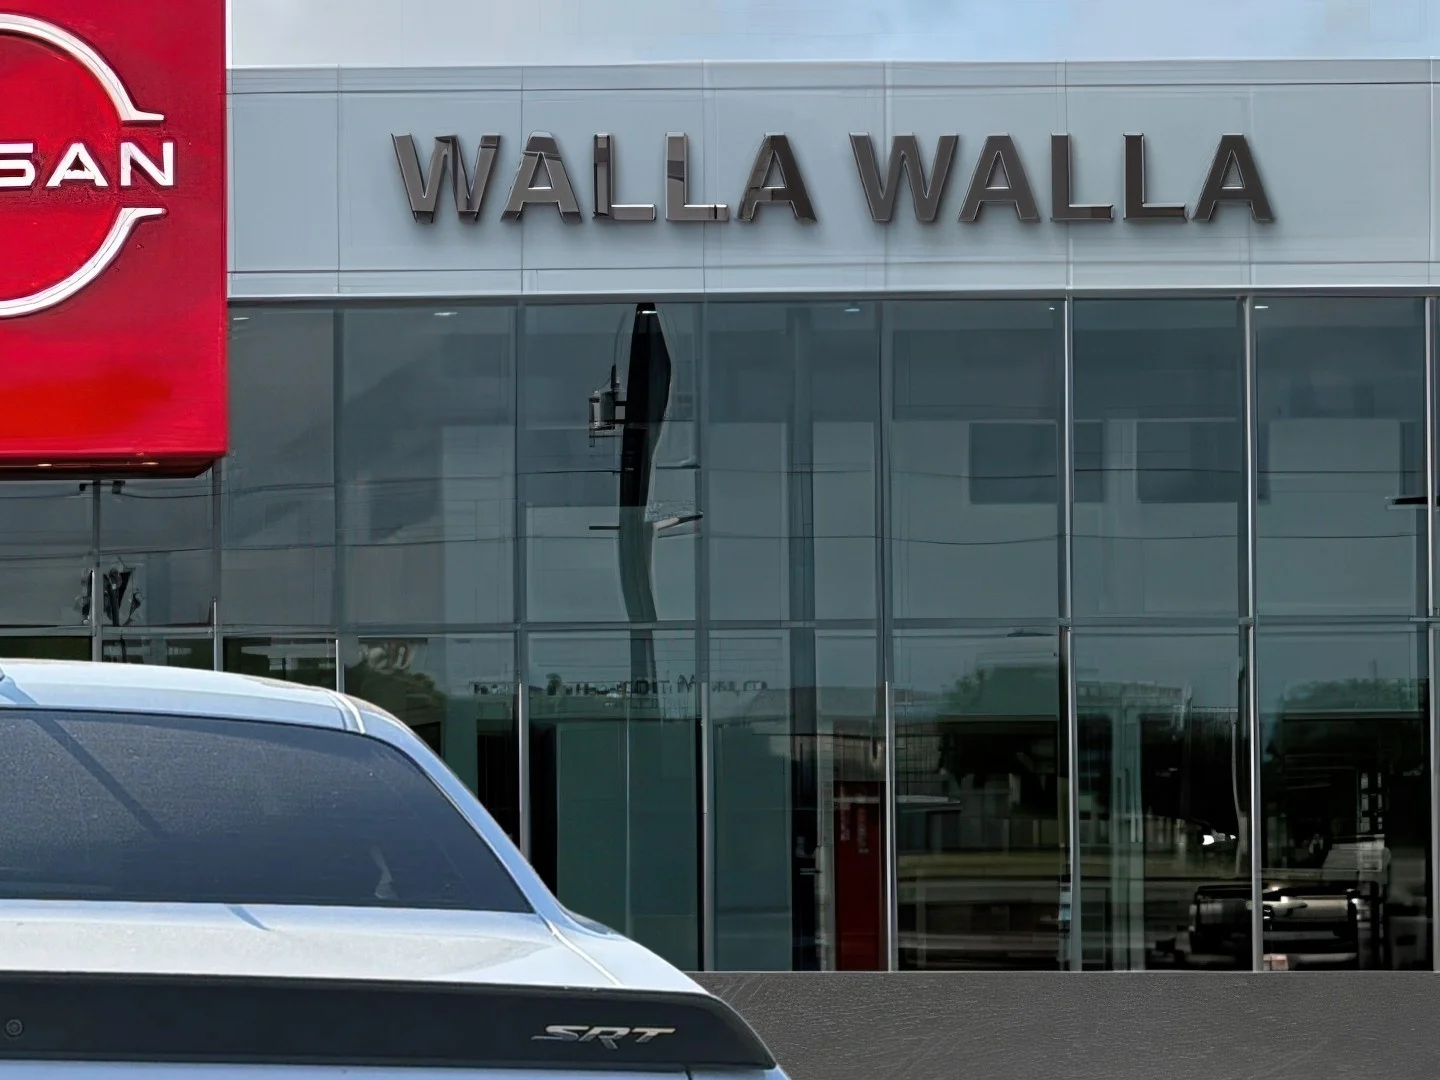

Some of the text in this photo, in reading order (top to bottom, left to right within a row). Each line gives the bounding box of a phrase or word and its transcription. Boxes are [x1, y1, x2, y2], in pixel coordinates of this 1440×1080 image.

[391, 132, 1274, 223] WALLA WALLA
[531, 1025, 676, 1050] SRT
